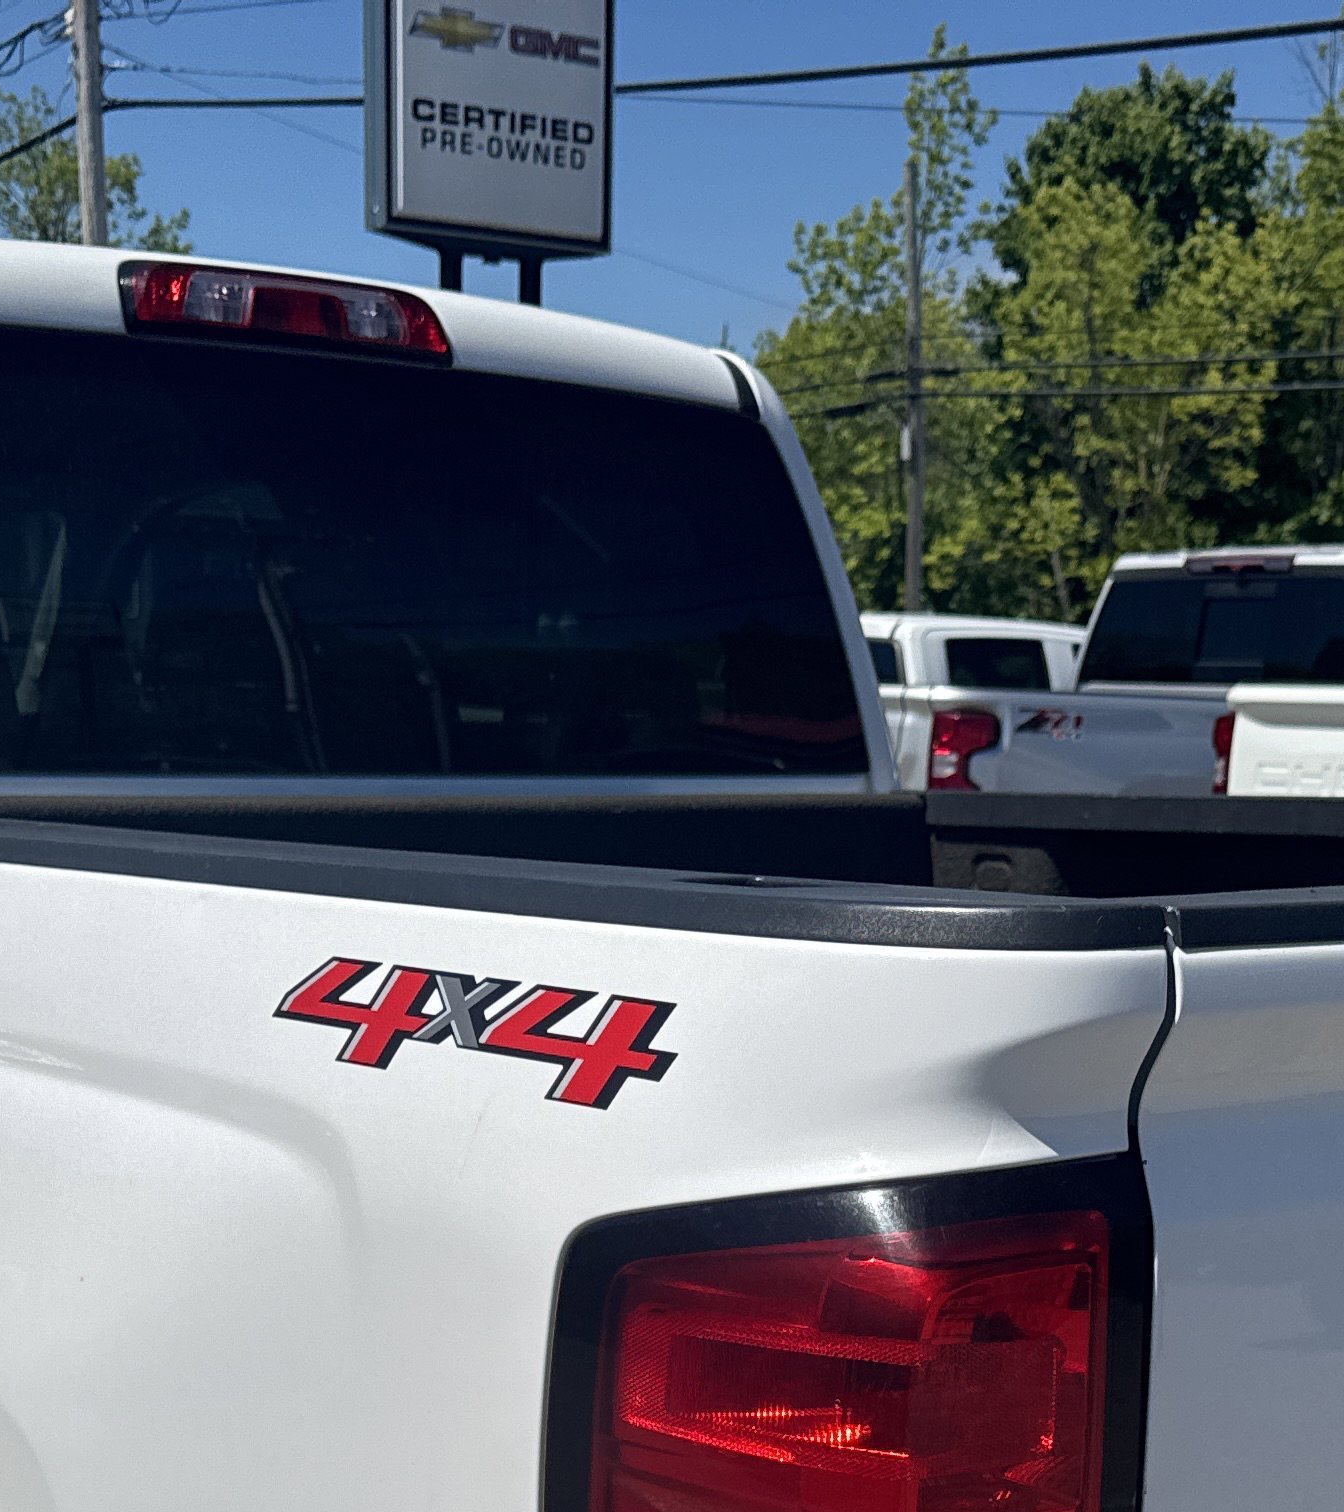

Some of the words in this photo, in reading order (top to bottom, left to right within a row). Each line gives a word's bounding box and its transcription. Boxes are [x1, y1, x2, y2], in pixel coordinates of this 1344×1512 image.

[509, 25, 600, 68] GMC
[412, 98, 594, 146] CERTIFIED
[421, 127, 586, 171] PRE-OWNED
